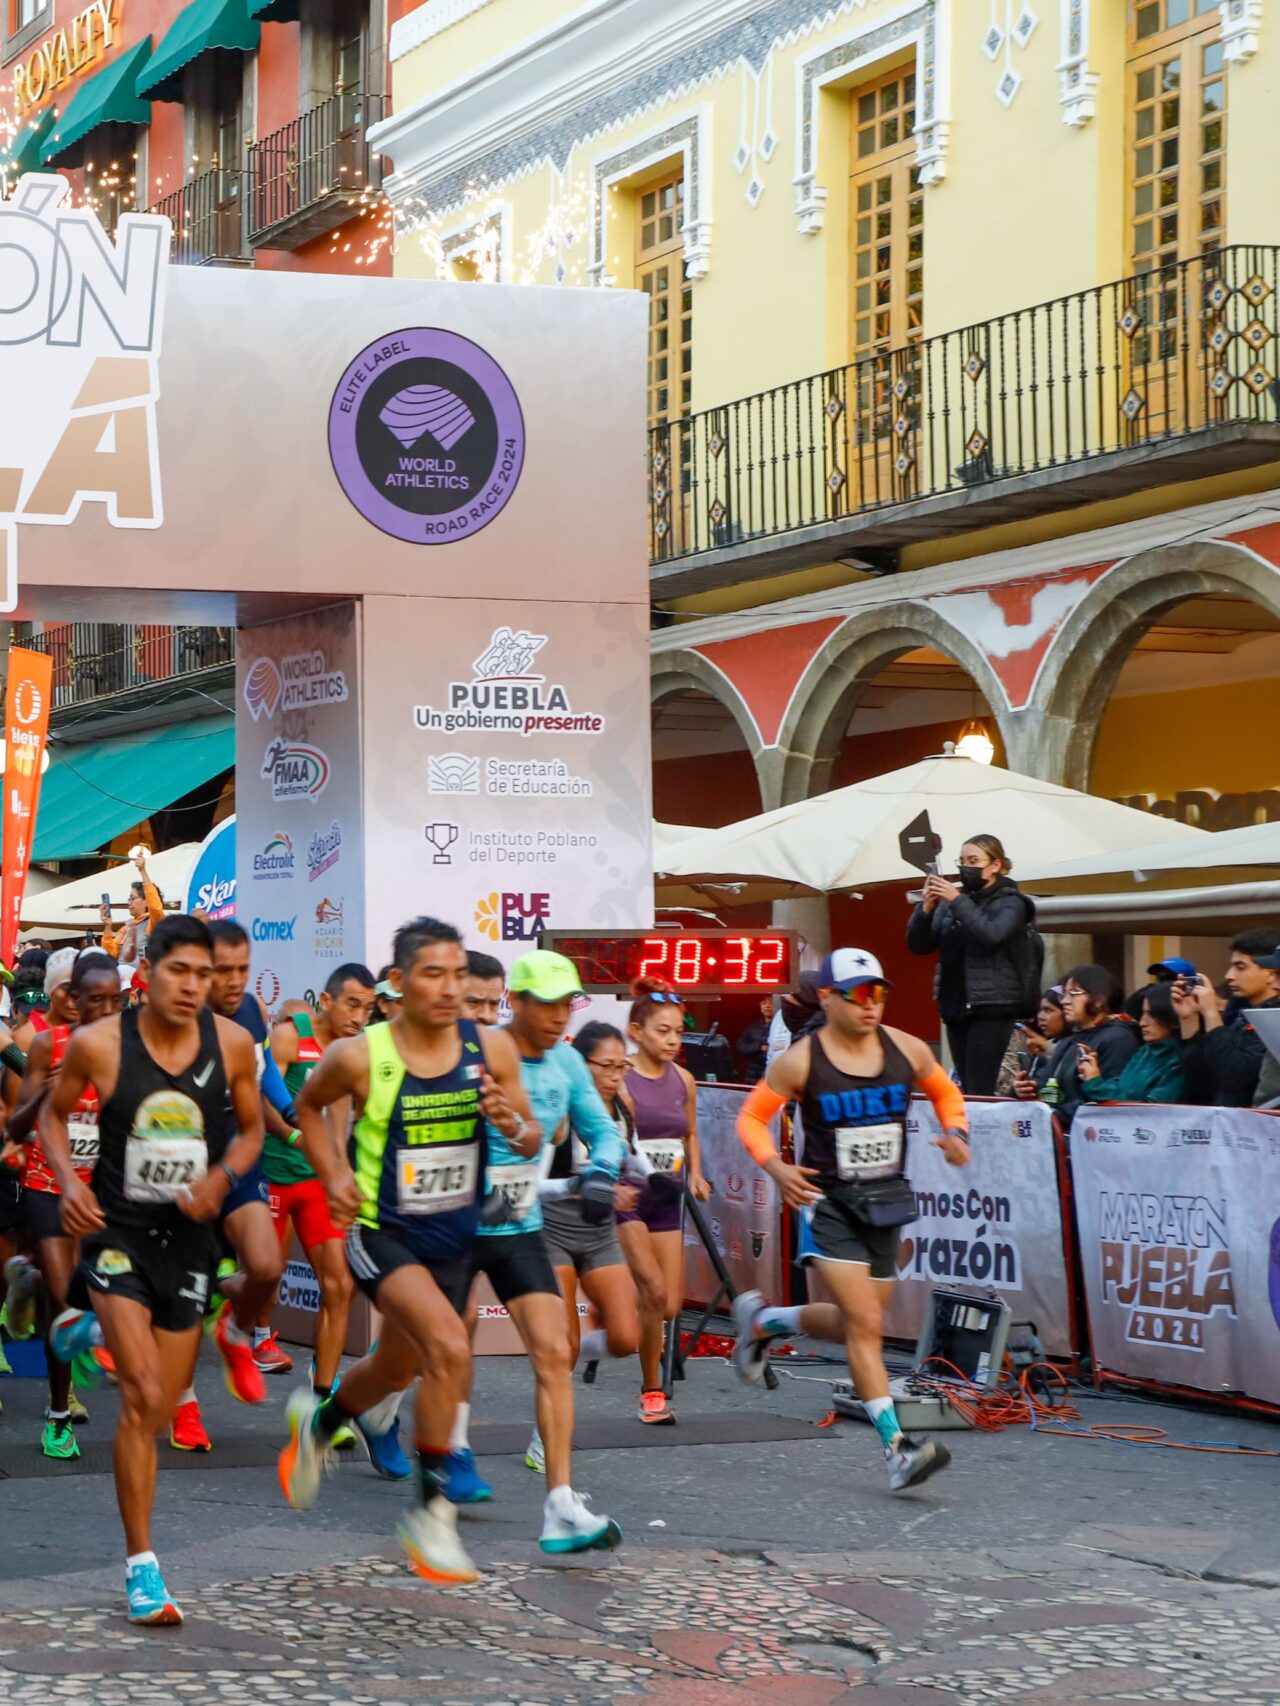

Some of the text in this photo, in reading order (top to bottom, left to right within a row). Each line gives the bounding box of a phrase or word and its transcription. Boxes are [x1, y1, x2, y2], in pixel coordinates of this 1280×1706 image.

[13, 0, 115, 115] ROYALTY
[339, 340, 411, 414] ELITE LABEL
[399, 457, 456, 472] WORLD
[385, 473, 469, 489] ATHLETICS
[425, 438, 517, 535] ROAD RACE 2024
[283, 656, 323, 680] WORLD
[283, 677, 343, 704] ATHLETICS
[452, 685, 568, 711] PUEBLA
[416, 708, 602, 734] Un gobierno presente
[275, 760, 310, 784] FMAA
[488, 760, 566, 777] Secretaría
[274, 784, 310, 797] atletismo
[488, 778, 591, 795] de Educación
[470, 831, 597, 847] Instituto Poblano
[253, 854, 295, 870] Electrolit
[469, 848, 557, 865] del Deporte
[253, 915, 297, 941] Comex
[818, 1083, 907, 1123] DUKE
[1100, 1241, 1237, 1318] PUEBLA
[1135, 1315, 1200, 1345] 2024
